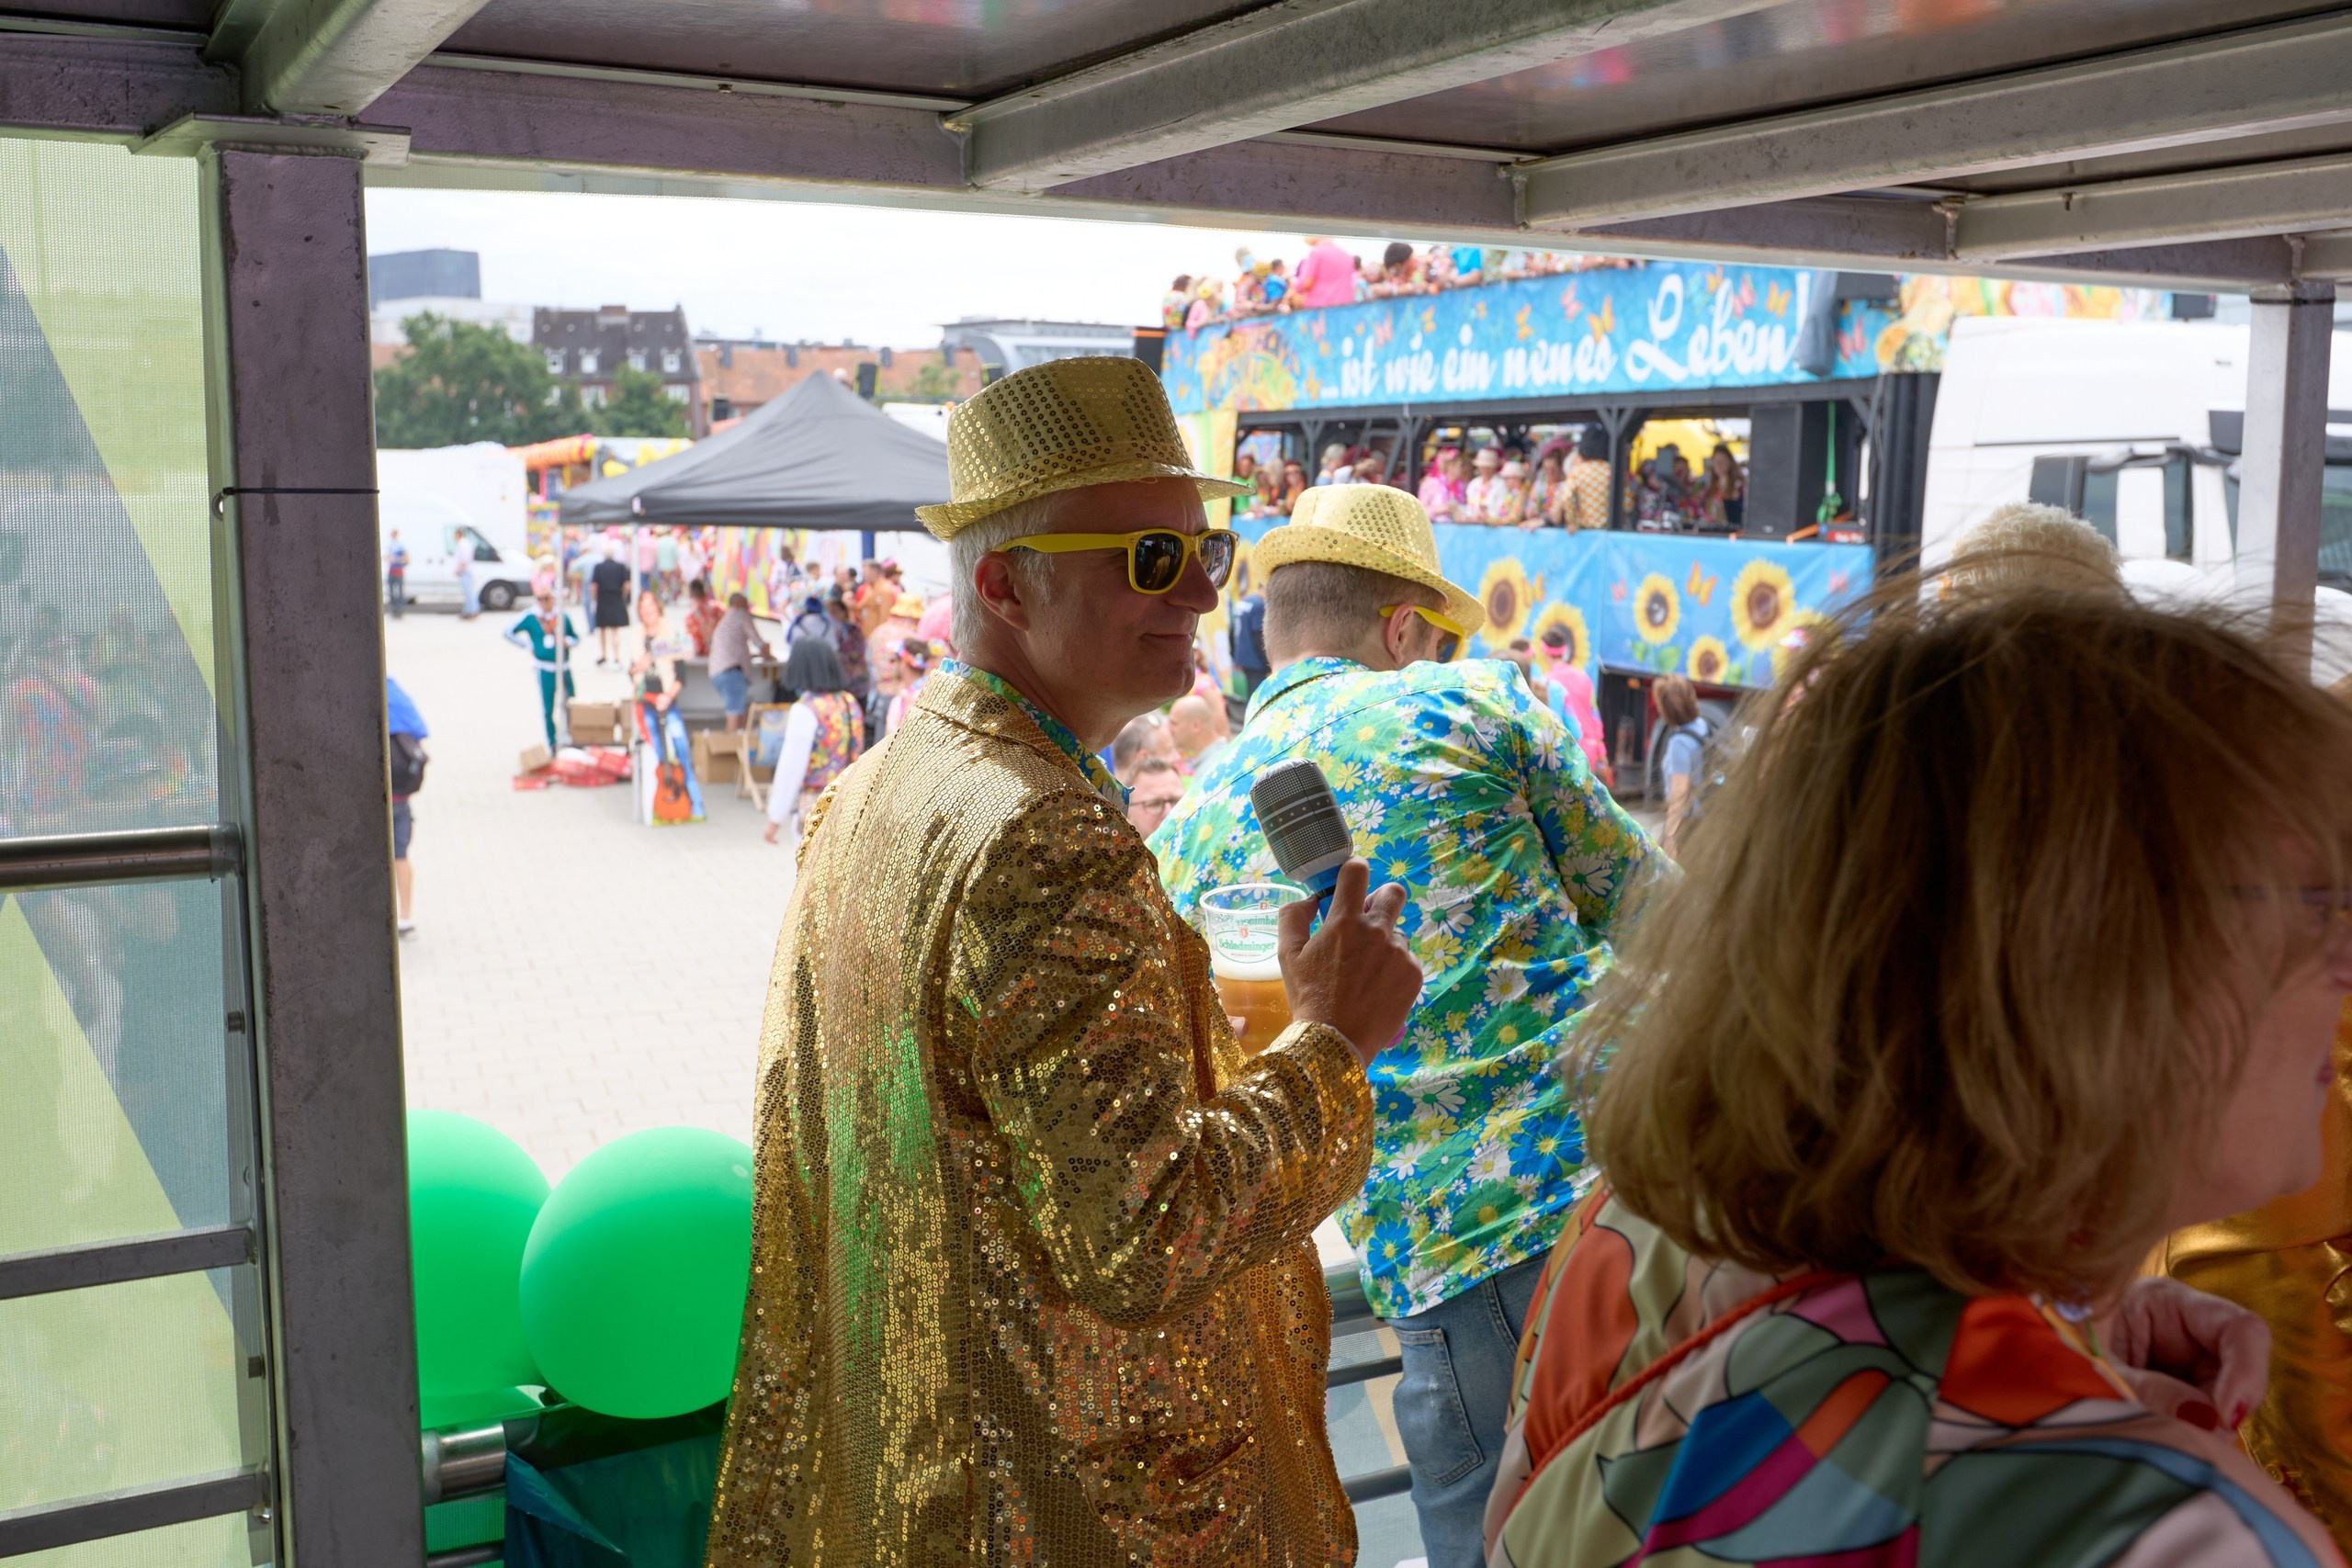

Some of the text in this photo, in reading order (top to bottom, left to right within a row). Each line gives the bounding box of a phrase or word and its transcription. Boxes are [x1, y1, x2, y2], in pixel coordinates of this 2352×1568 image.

[1385, 331, 1440, 395] wie
[1442, 322, 1498, 392] ein
[1502, 333, 1618, 389] neues
[1218, 938, 1276, 953] Schladminger
